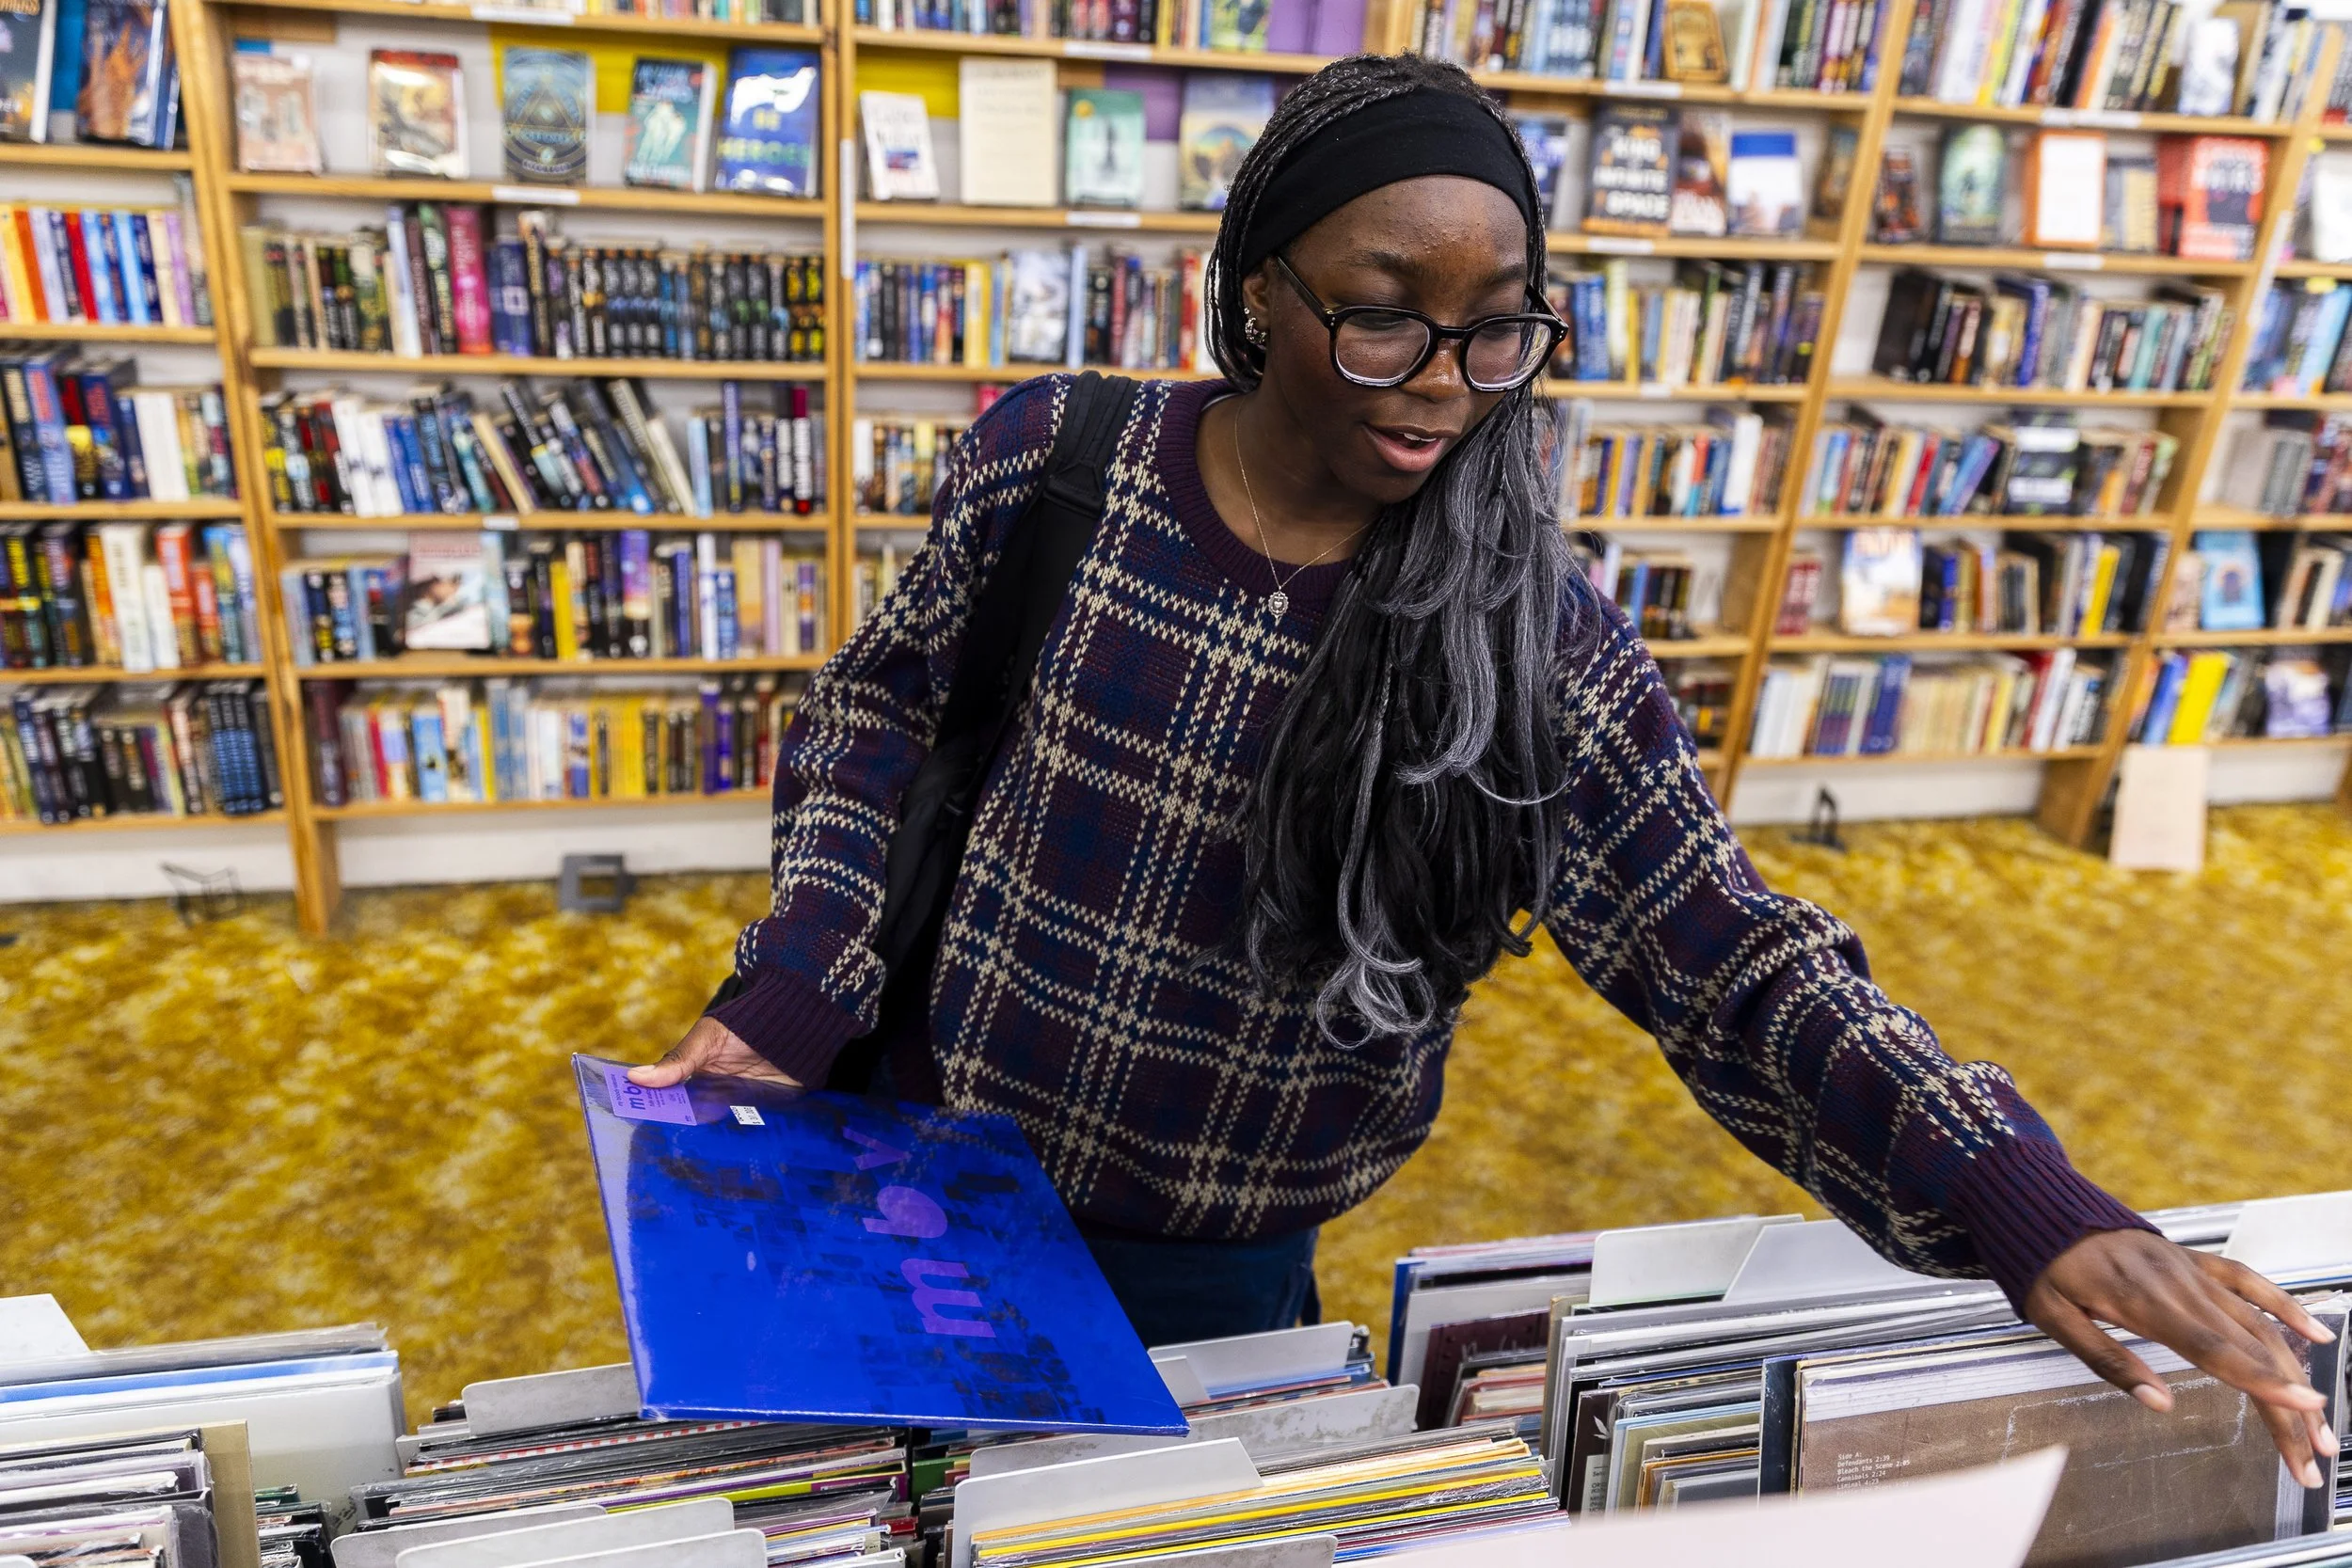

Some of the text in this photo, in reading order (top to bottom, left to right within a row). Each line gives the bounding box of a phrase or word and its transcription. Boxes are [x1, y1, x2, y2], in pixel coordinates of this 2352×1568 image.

[1836, 1458, 1873, 1467] Defendants
[1896, 1459, 1911, 1467] 2:05
[1836, 1473, 1869, 1482] Cannibals
[1836, 1481, 1862, 1490] Liminal
